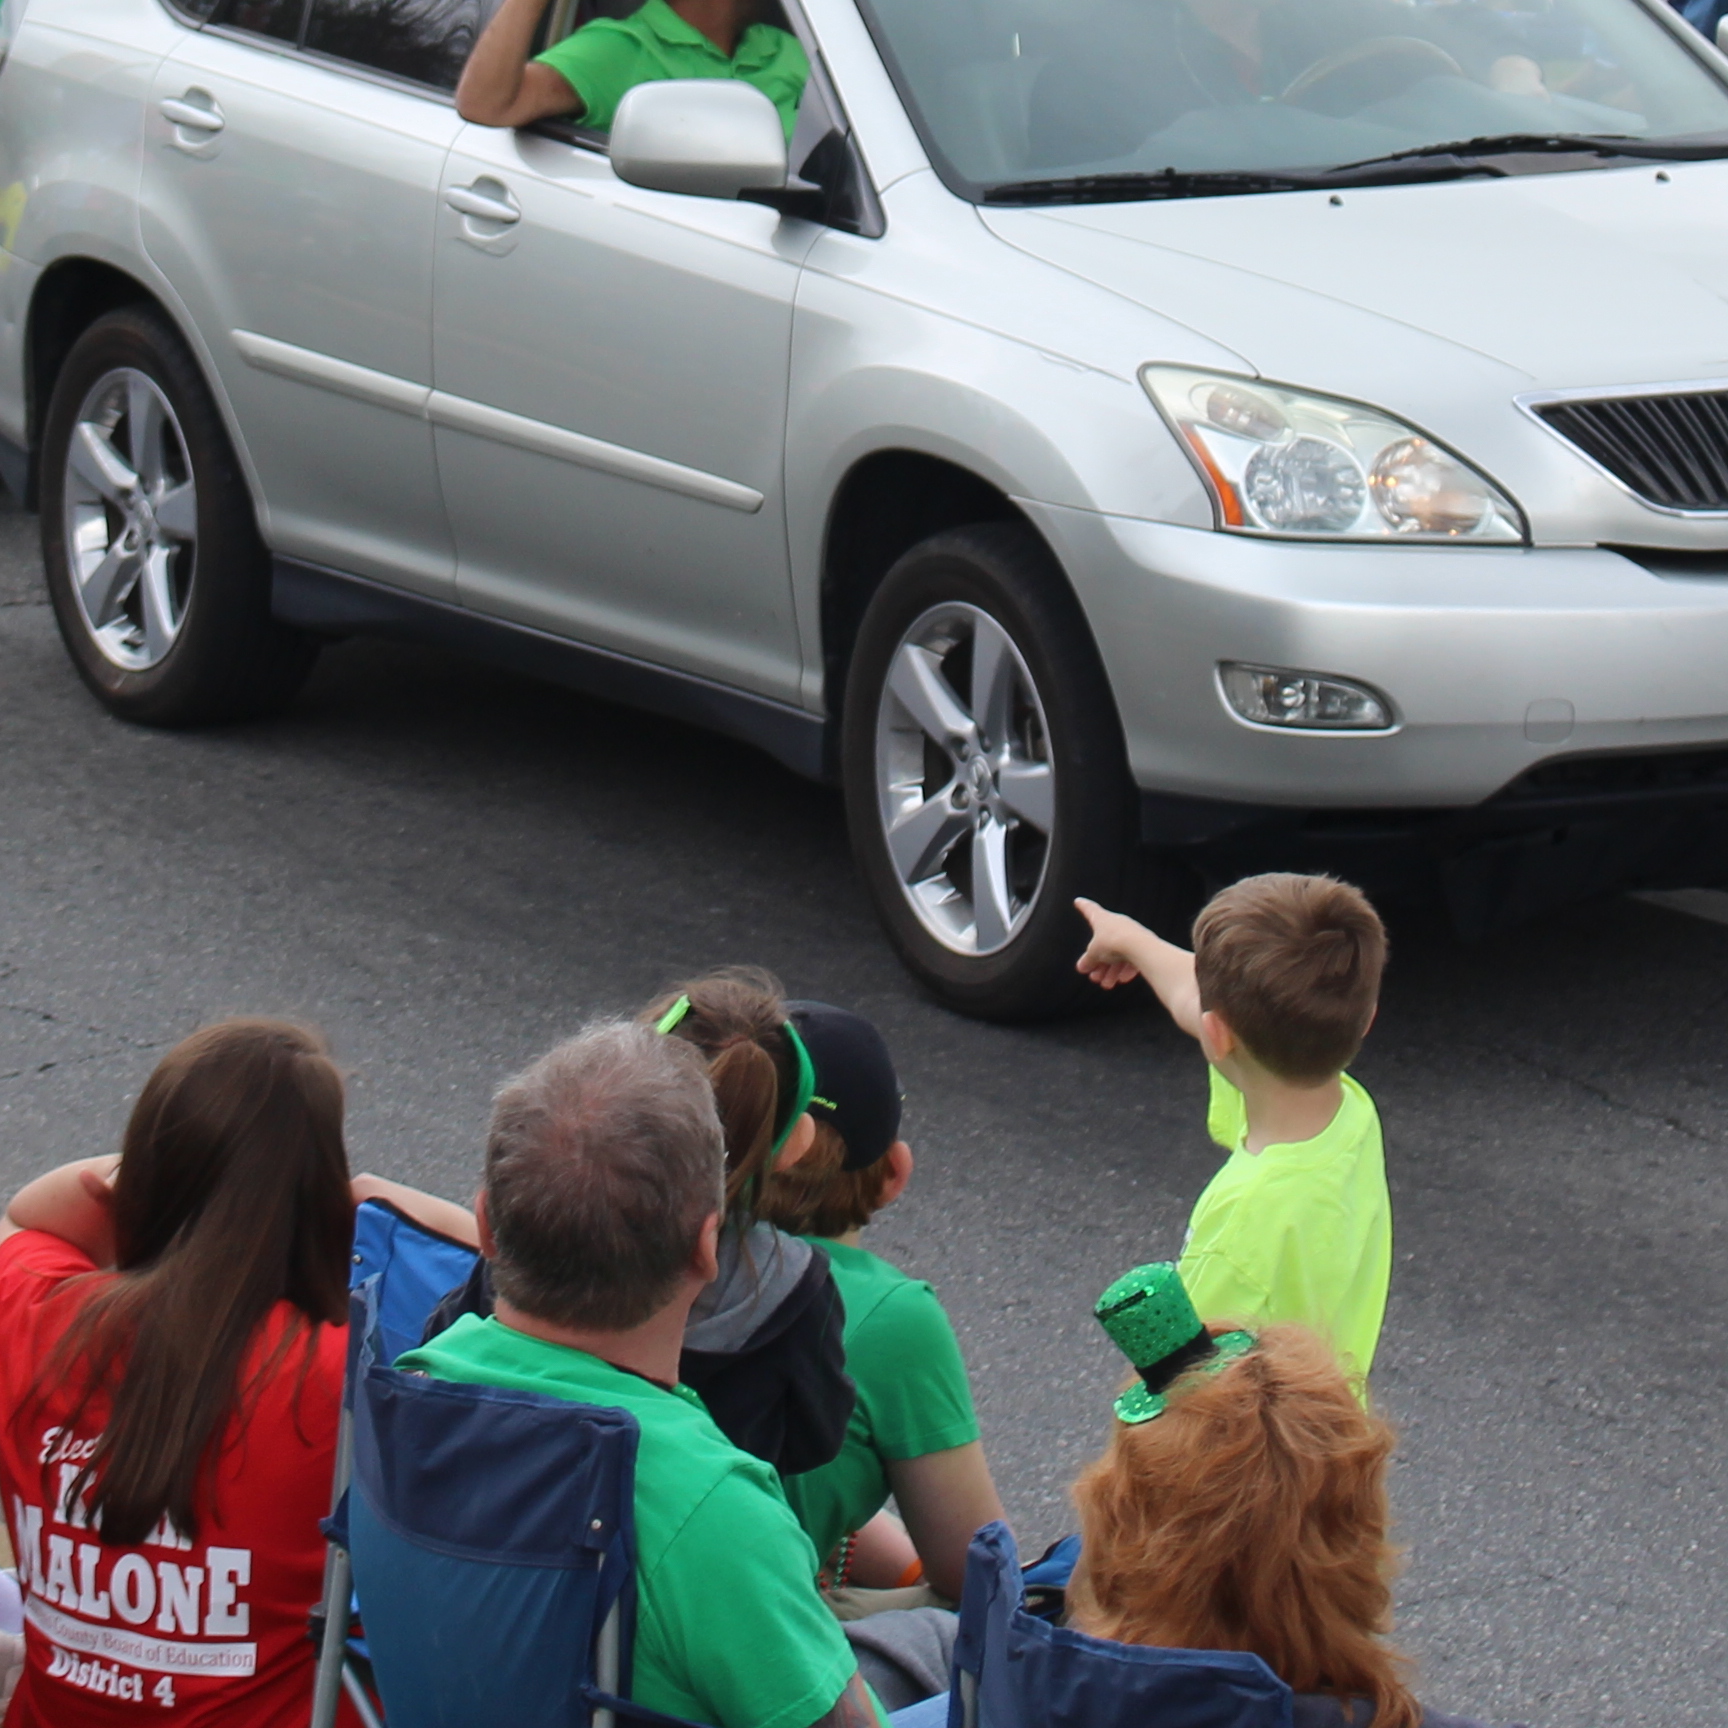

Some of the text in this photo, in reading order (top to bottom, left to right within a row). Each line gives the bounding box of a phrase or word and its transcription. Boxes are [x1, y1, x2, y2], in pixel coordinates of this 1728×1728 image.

[14, 1493, 252, 1638] MALONE
[46, 1644, 176, 1707] District 4
[102, 1630, 143, 1658] Board
[147, 1645, 163, 1662] of
[166, 1645, 255, 1670] Education
